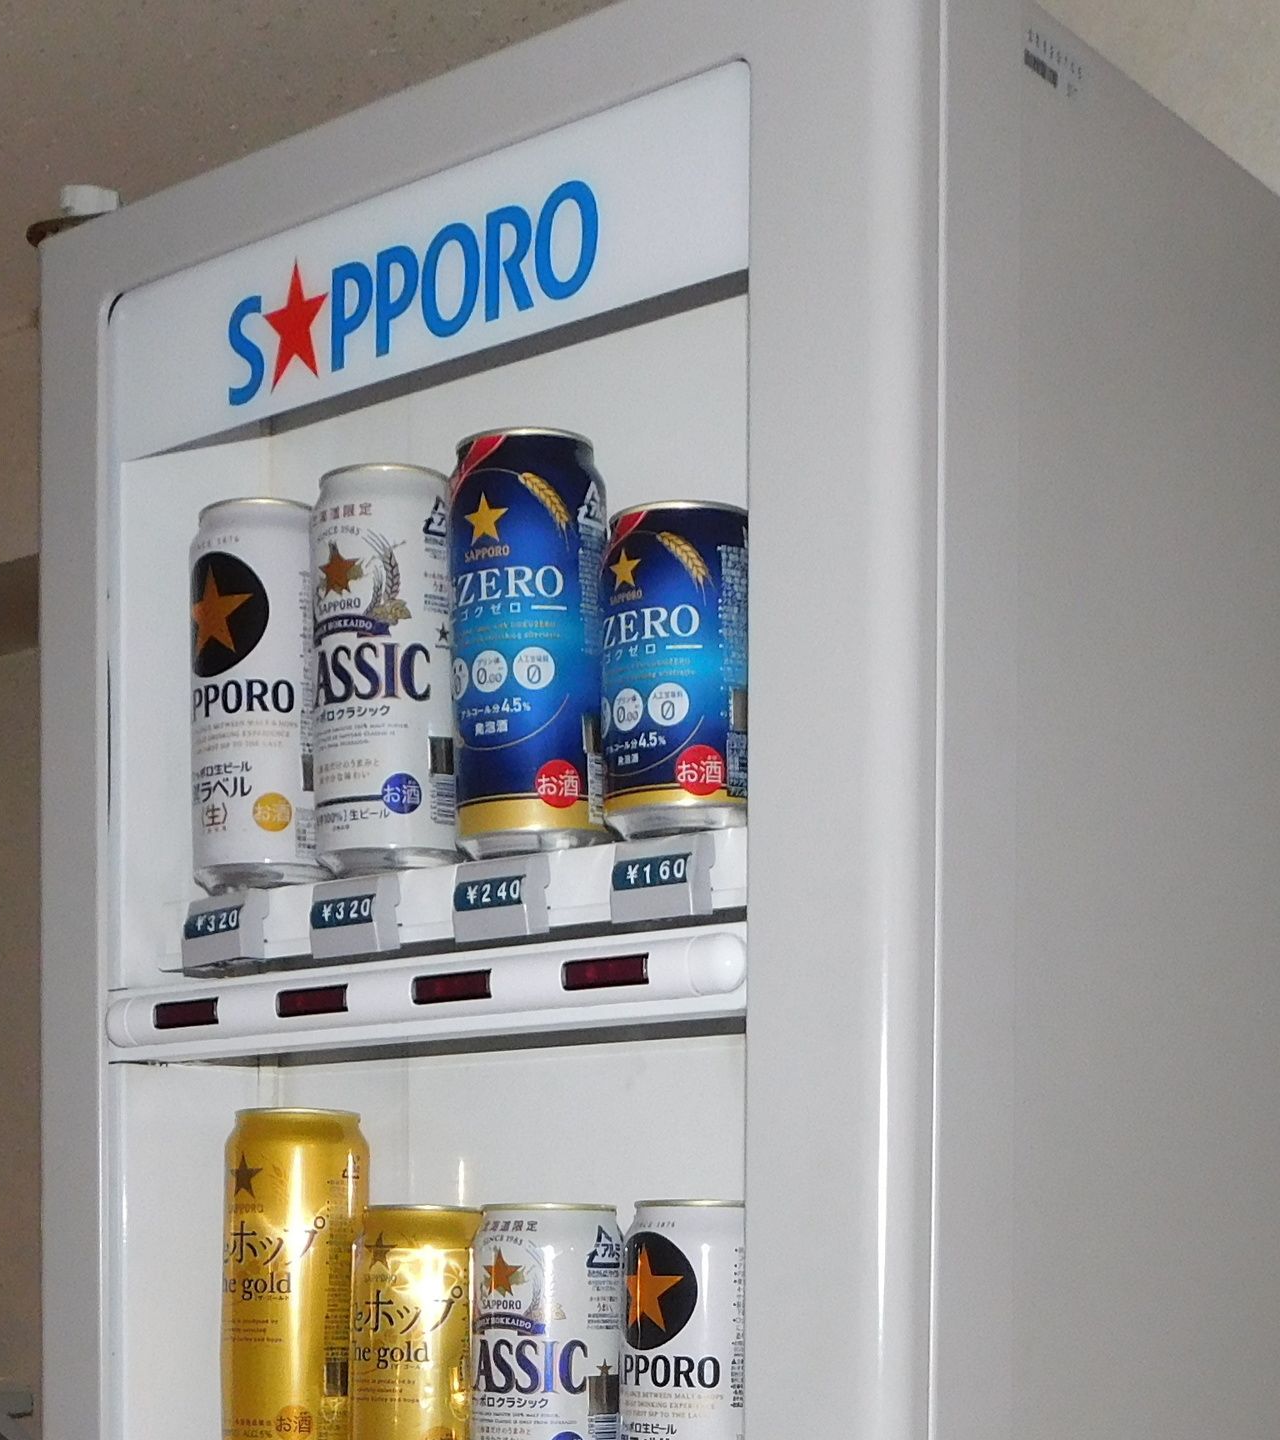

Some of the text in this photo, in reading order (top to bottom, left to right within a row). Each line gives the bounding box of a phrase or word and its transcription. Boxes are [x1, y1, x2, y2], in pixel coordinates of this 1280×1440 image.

[464, 545, 510, 563] SAPPORO
[458, 565, 564, 607] ZERO
[603, 604, 700, 649] ZERO
[676, 760, 723, 784] お酒
[384, 782, 420, 804] お酒
[537, 772, 579, 797] お酒
[626, 858, 685, 884] ¥160
[466, 879, 521, 904] ¥240
[195, 909, 239, 931] ¥320
[321, 898, 371, 922] ¥320
[242, 1272, 291, 1301] gold
[482, 1300, 522, 1310] SAPPORO
[491, 1317, 532, 1329] HOKKAIDO
[377, 1341, 430, 1370] gold
[276, 1415, 312, 1434] お酒
